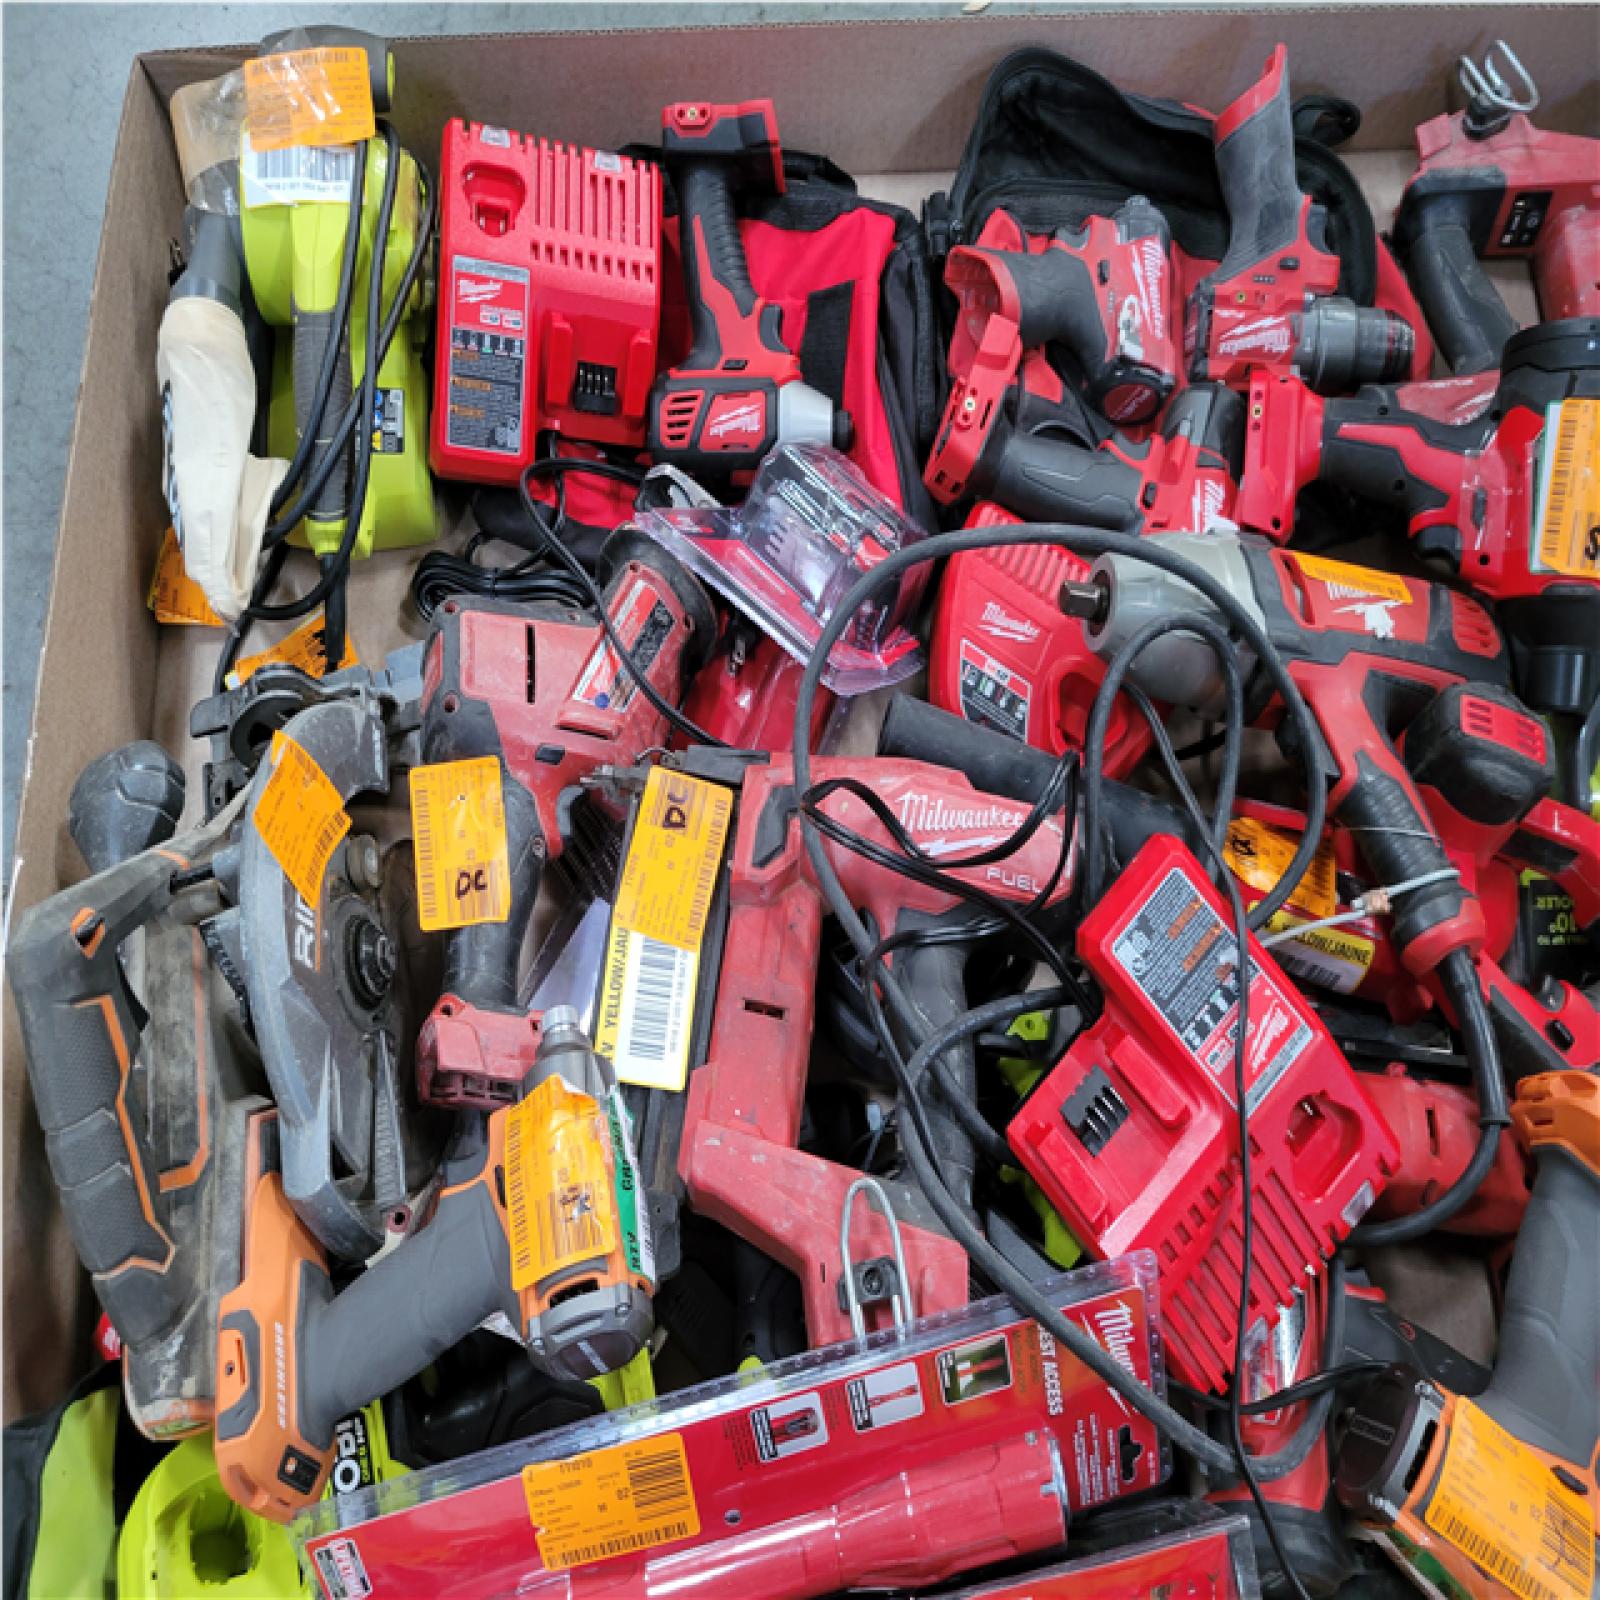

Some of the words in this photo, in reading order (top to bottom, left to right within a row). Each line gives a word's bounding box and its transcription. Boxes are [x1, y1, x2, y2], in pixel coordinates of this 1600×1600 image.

[895, 790, 1026, 832] Milwaukee
[986, 867, 1041, 894] FUEL
[1042, 1361, 1064, 1416] ACCESS
